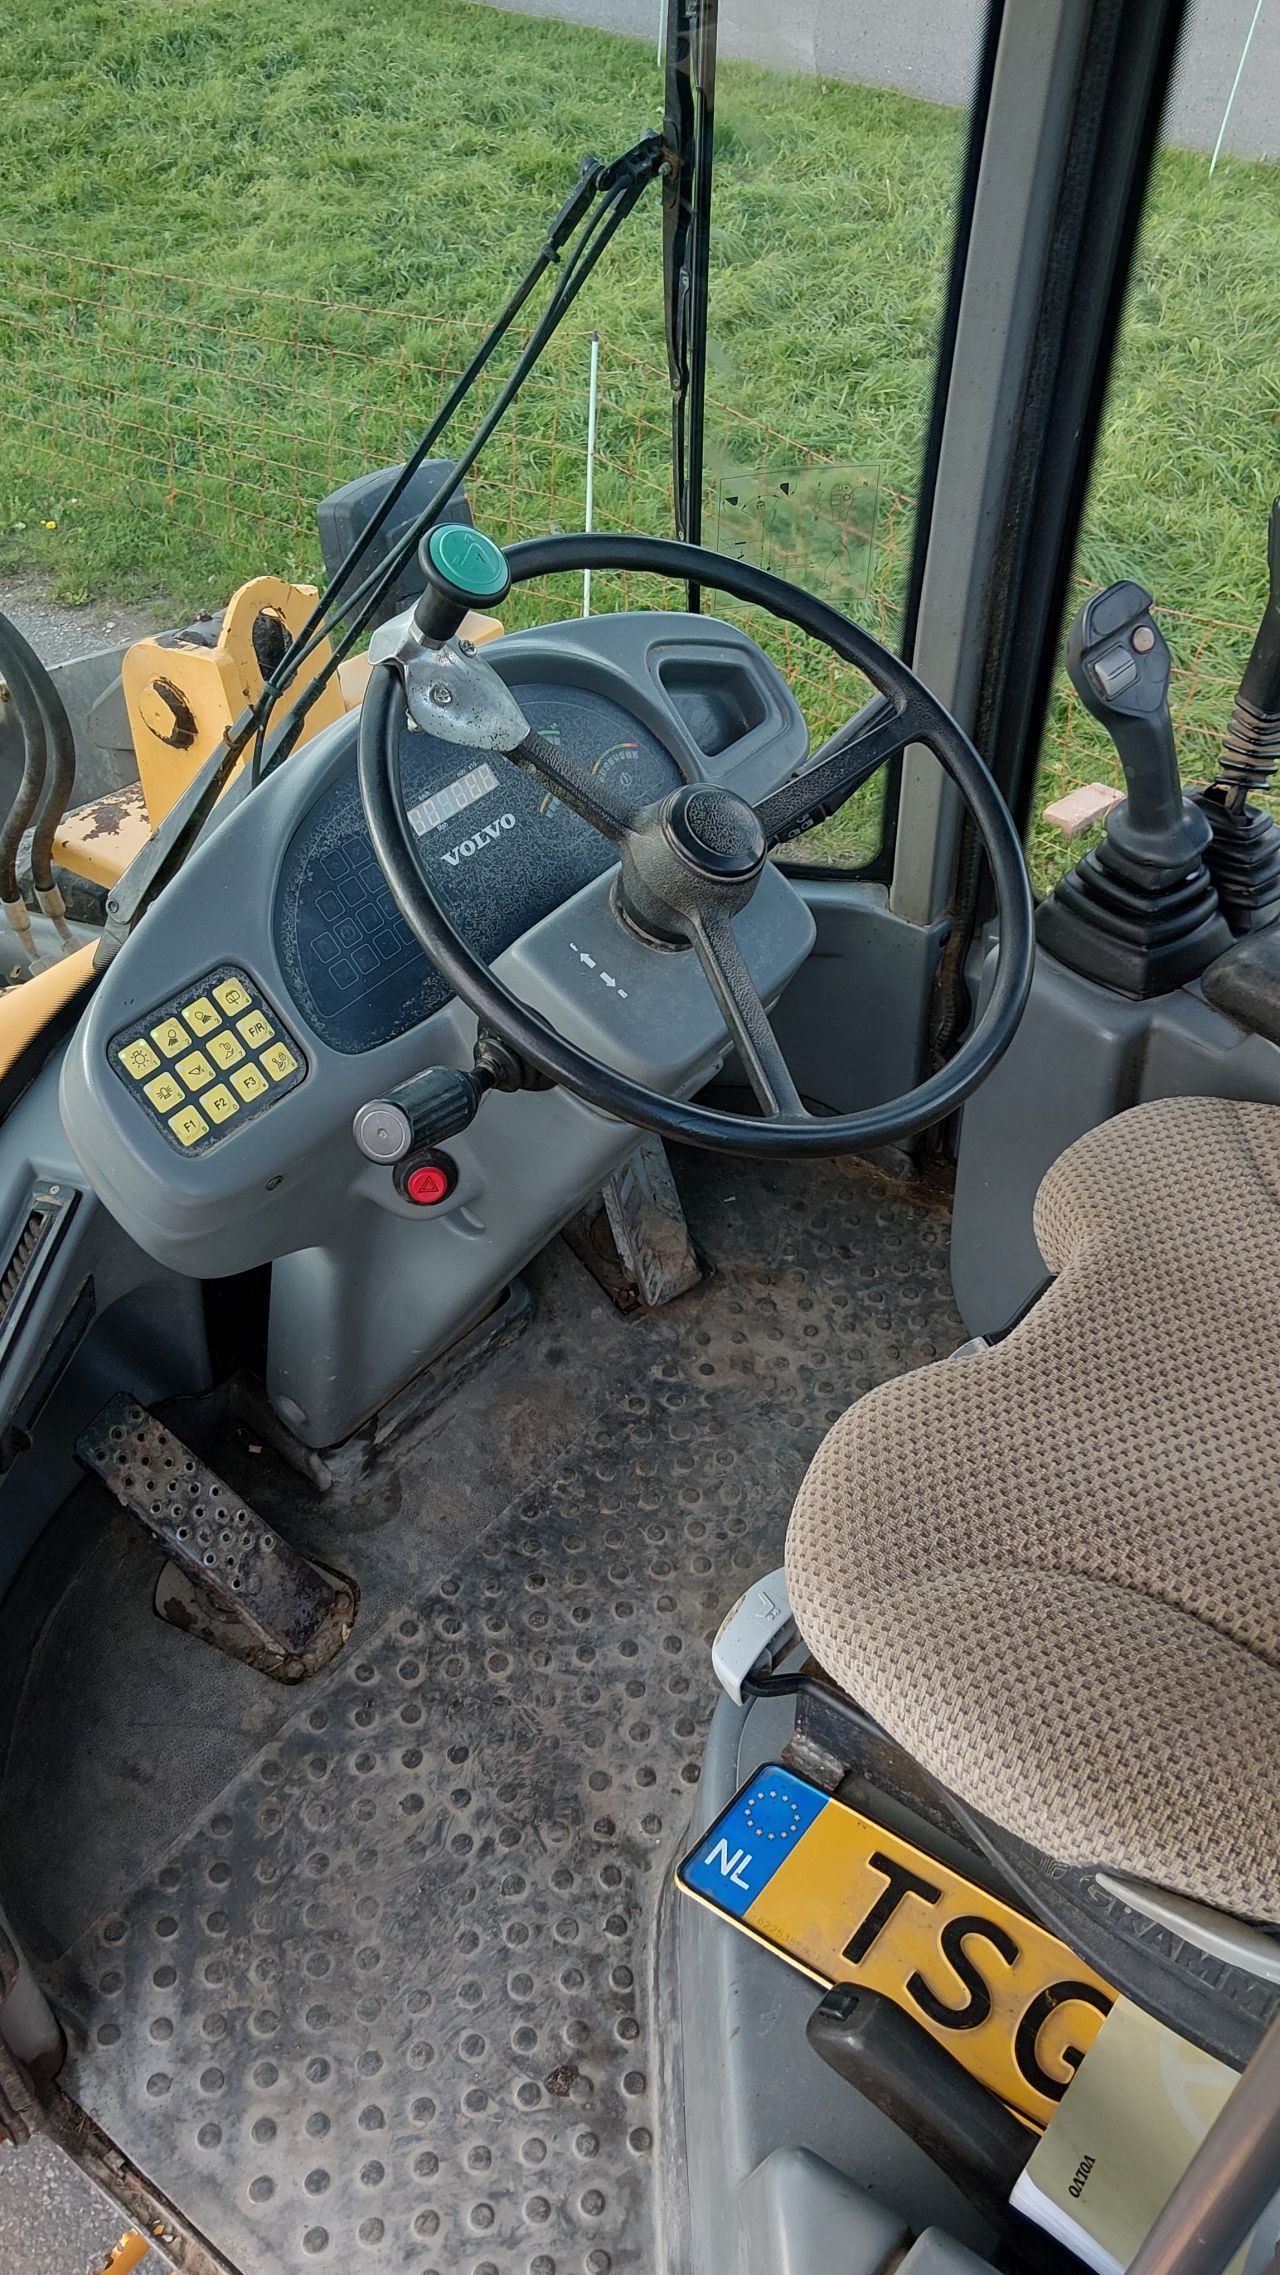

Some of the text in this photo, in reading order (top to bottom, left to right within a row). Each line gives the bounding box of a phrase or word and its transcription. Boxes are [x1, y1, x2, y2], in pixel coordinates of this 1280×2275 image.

[441, 813, 516, 866] VOLVO
[248, 1022, 265, 1038] F/R
[243, 1076, 257, 1089] F3
[213, 1097, 227, 1111] F2
[183, 1119, 197, 1133] F1
[704, 1838, 752, 1890] NL
[842, 1851, 1115, 2102] TSG
[1069, 2155, 1096, 2198] VOLVO
